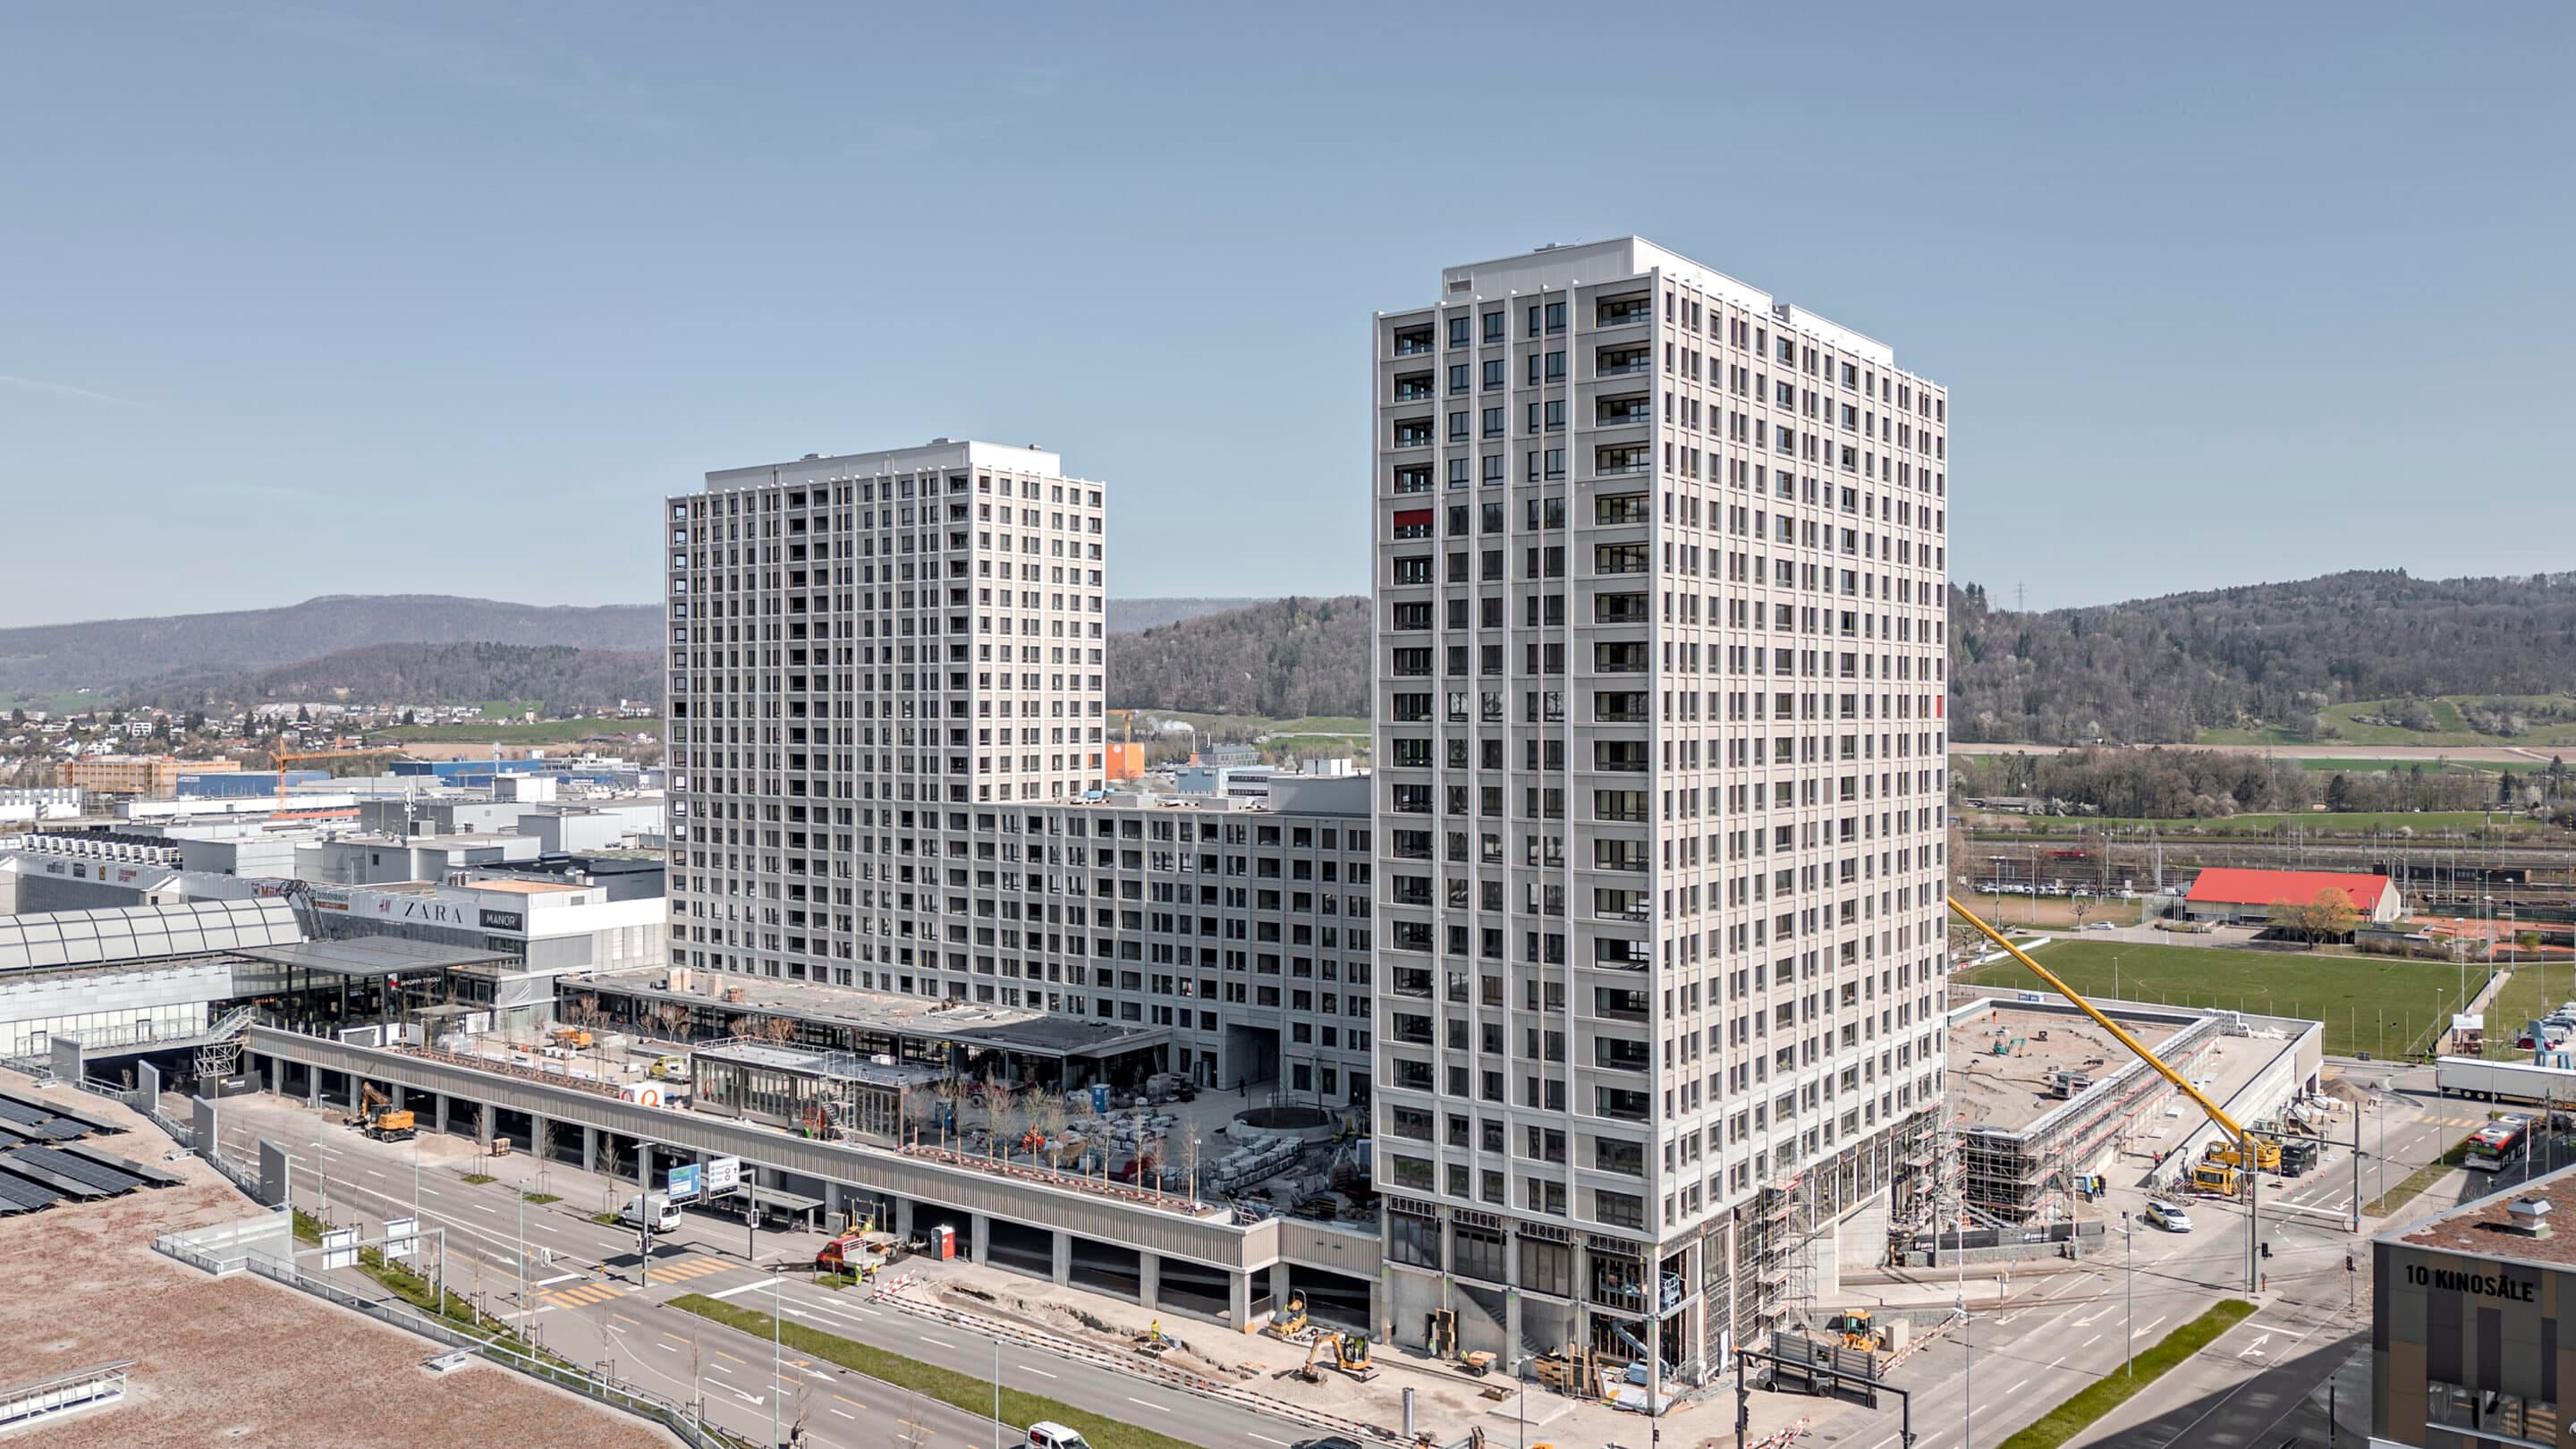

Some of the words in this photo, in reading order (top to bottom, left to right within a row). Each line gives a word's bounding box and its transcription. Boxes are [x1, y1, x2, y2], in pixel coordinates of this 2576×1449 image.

[404, 901, 462, 924] ZARA
[486, 913, 515, 927] MANOR
[2406, 1264, 2428, 1285] 10
[2436, 1268, 2534, 1302] KINOSÄLE
